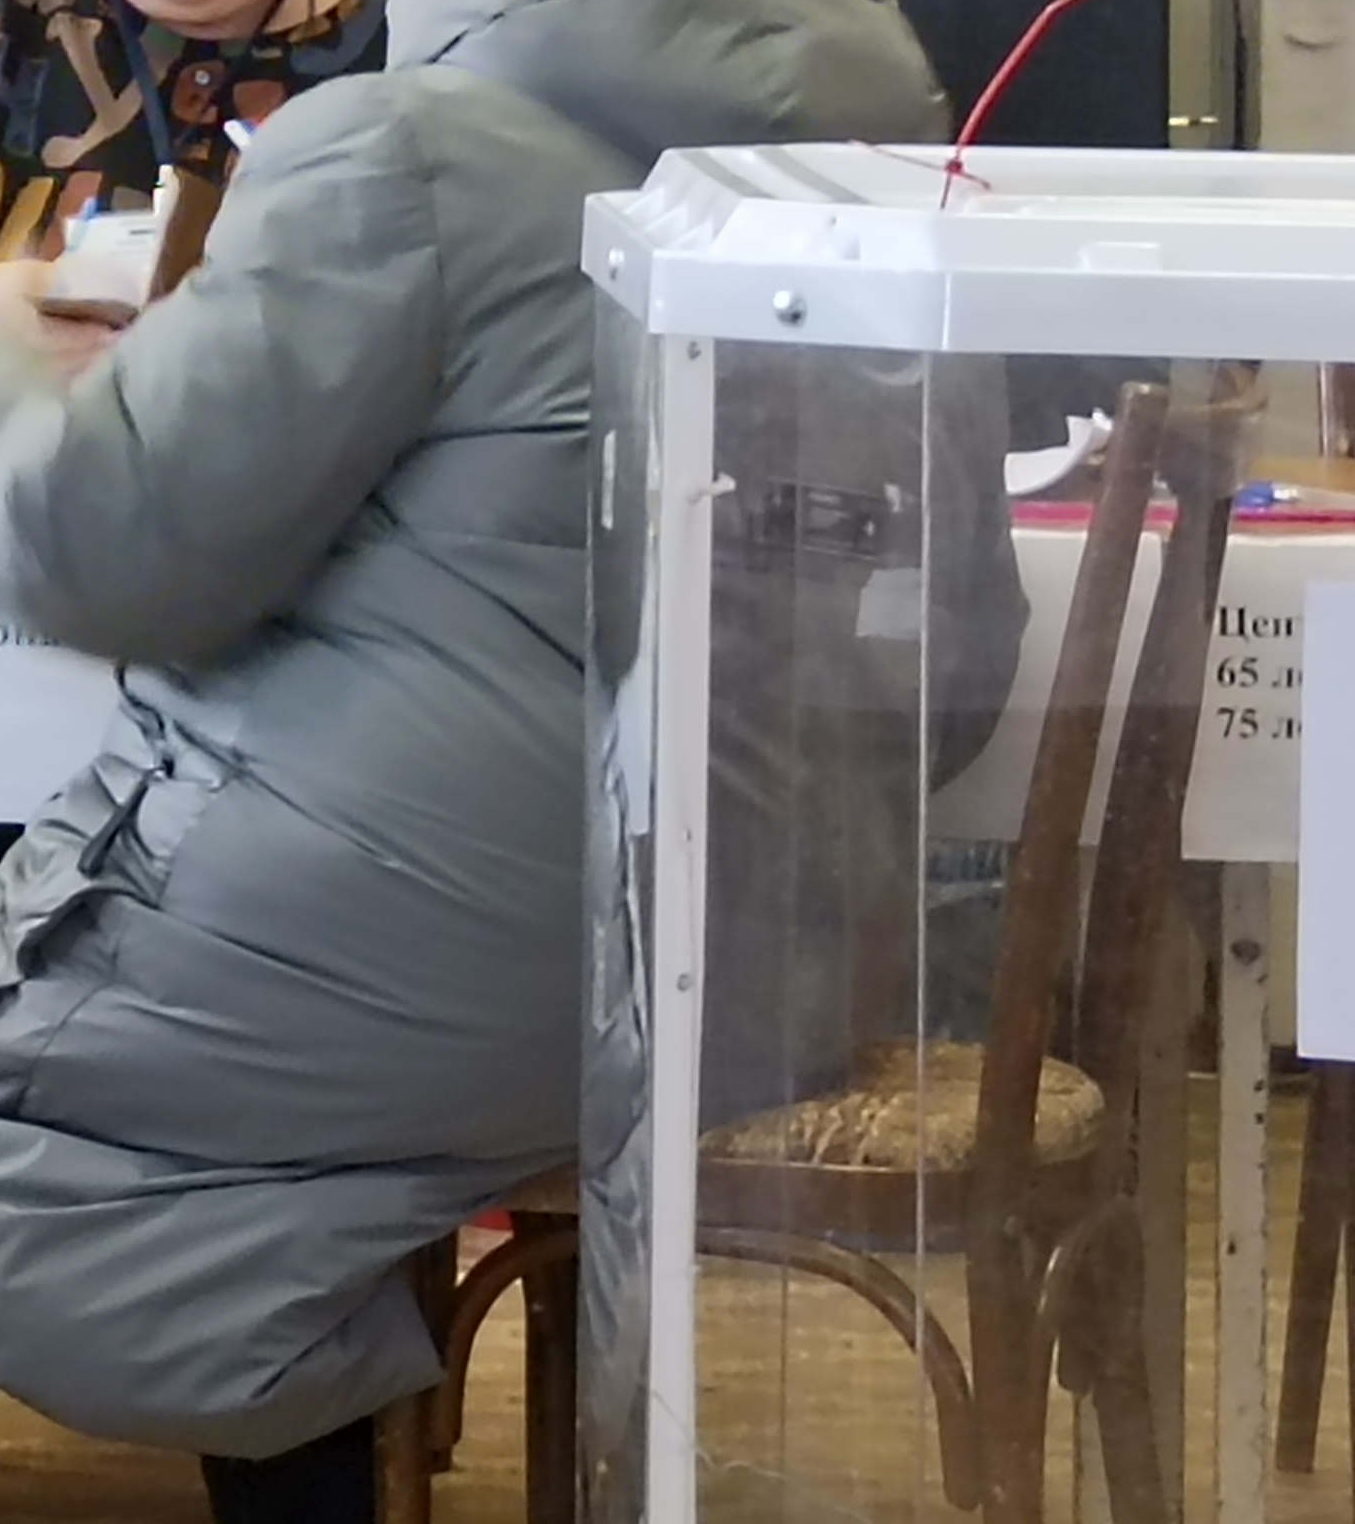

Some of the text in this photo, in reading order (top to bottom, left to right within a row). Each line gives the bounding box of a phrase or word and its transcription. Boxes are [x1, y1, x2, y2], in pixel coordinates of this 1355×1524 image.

[1218, 606, 1297, 642] Цен
[1216, 656, 1259, 688] 65
[1216, 706, 1259, 740] 75
